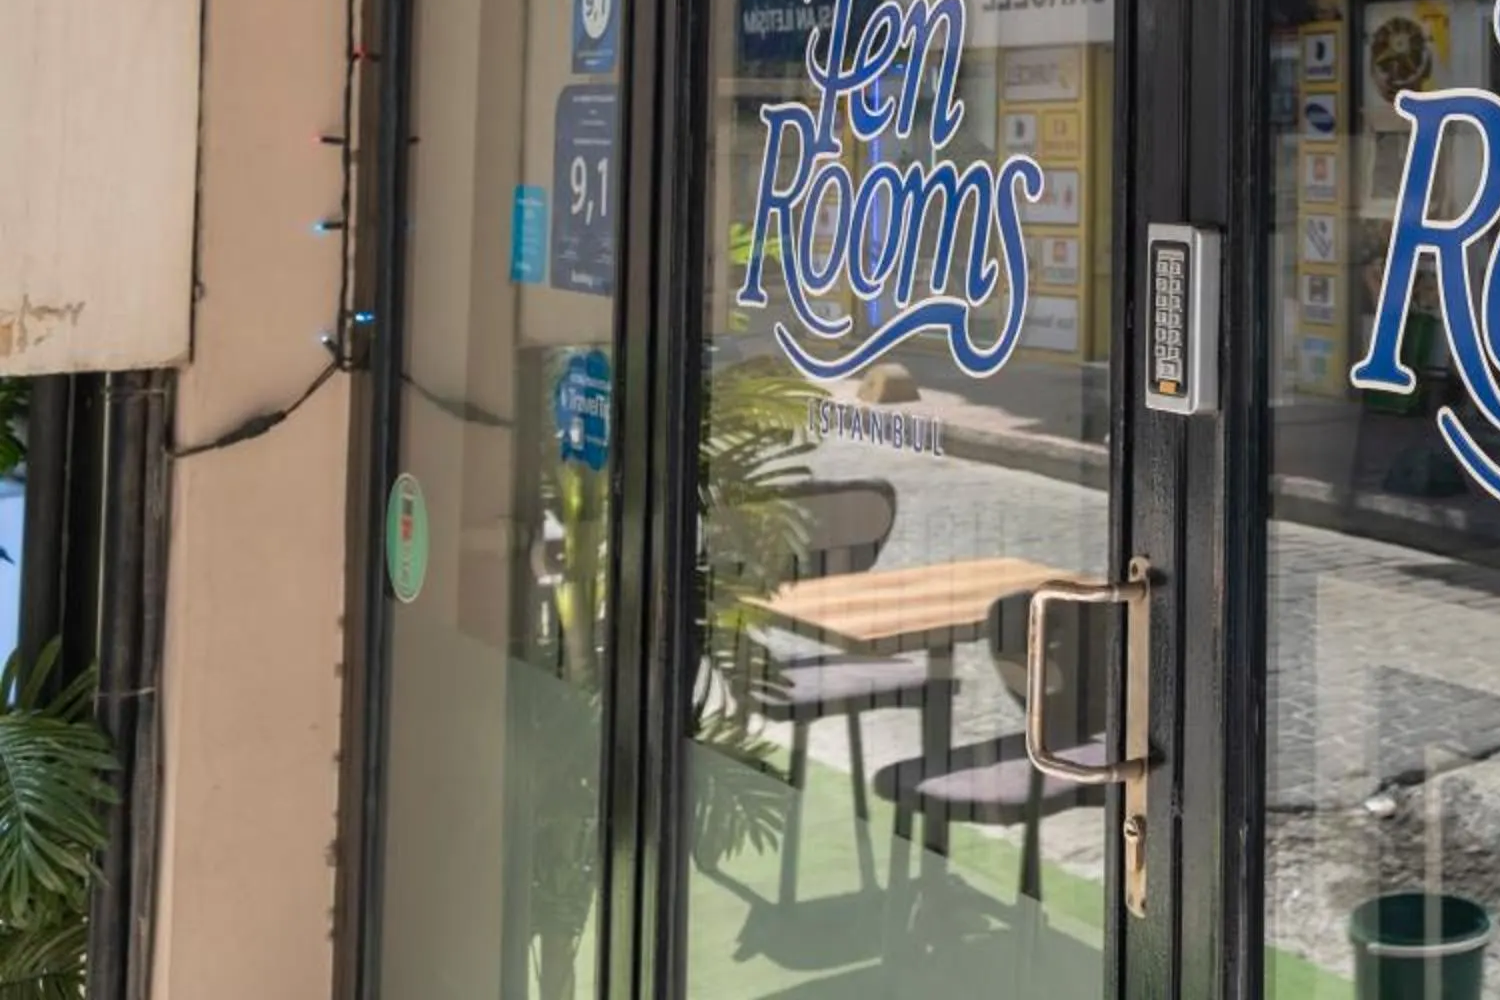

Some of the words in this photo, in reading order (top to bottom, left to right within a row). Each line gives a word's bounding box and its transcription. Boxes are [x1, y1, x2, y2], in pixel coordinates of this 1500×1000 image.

[570, 156, 609, 226] 9,1
[737, 103, 1045, 380] Rooms
[808, 399, 944, 457] ISTANBUL
